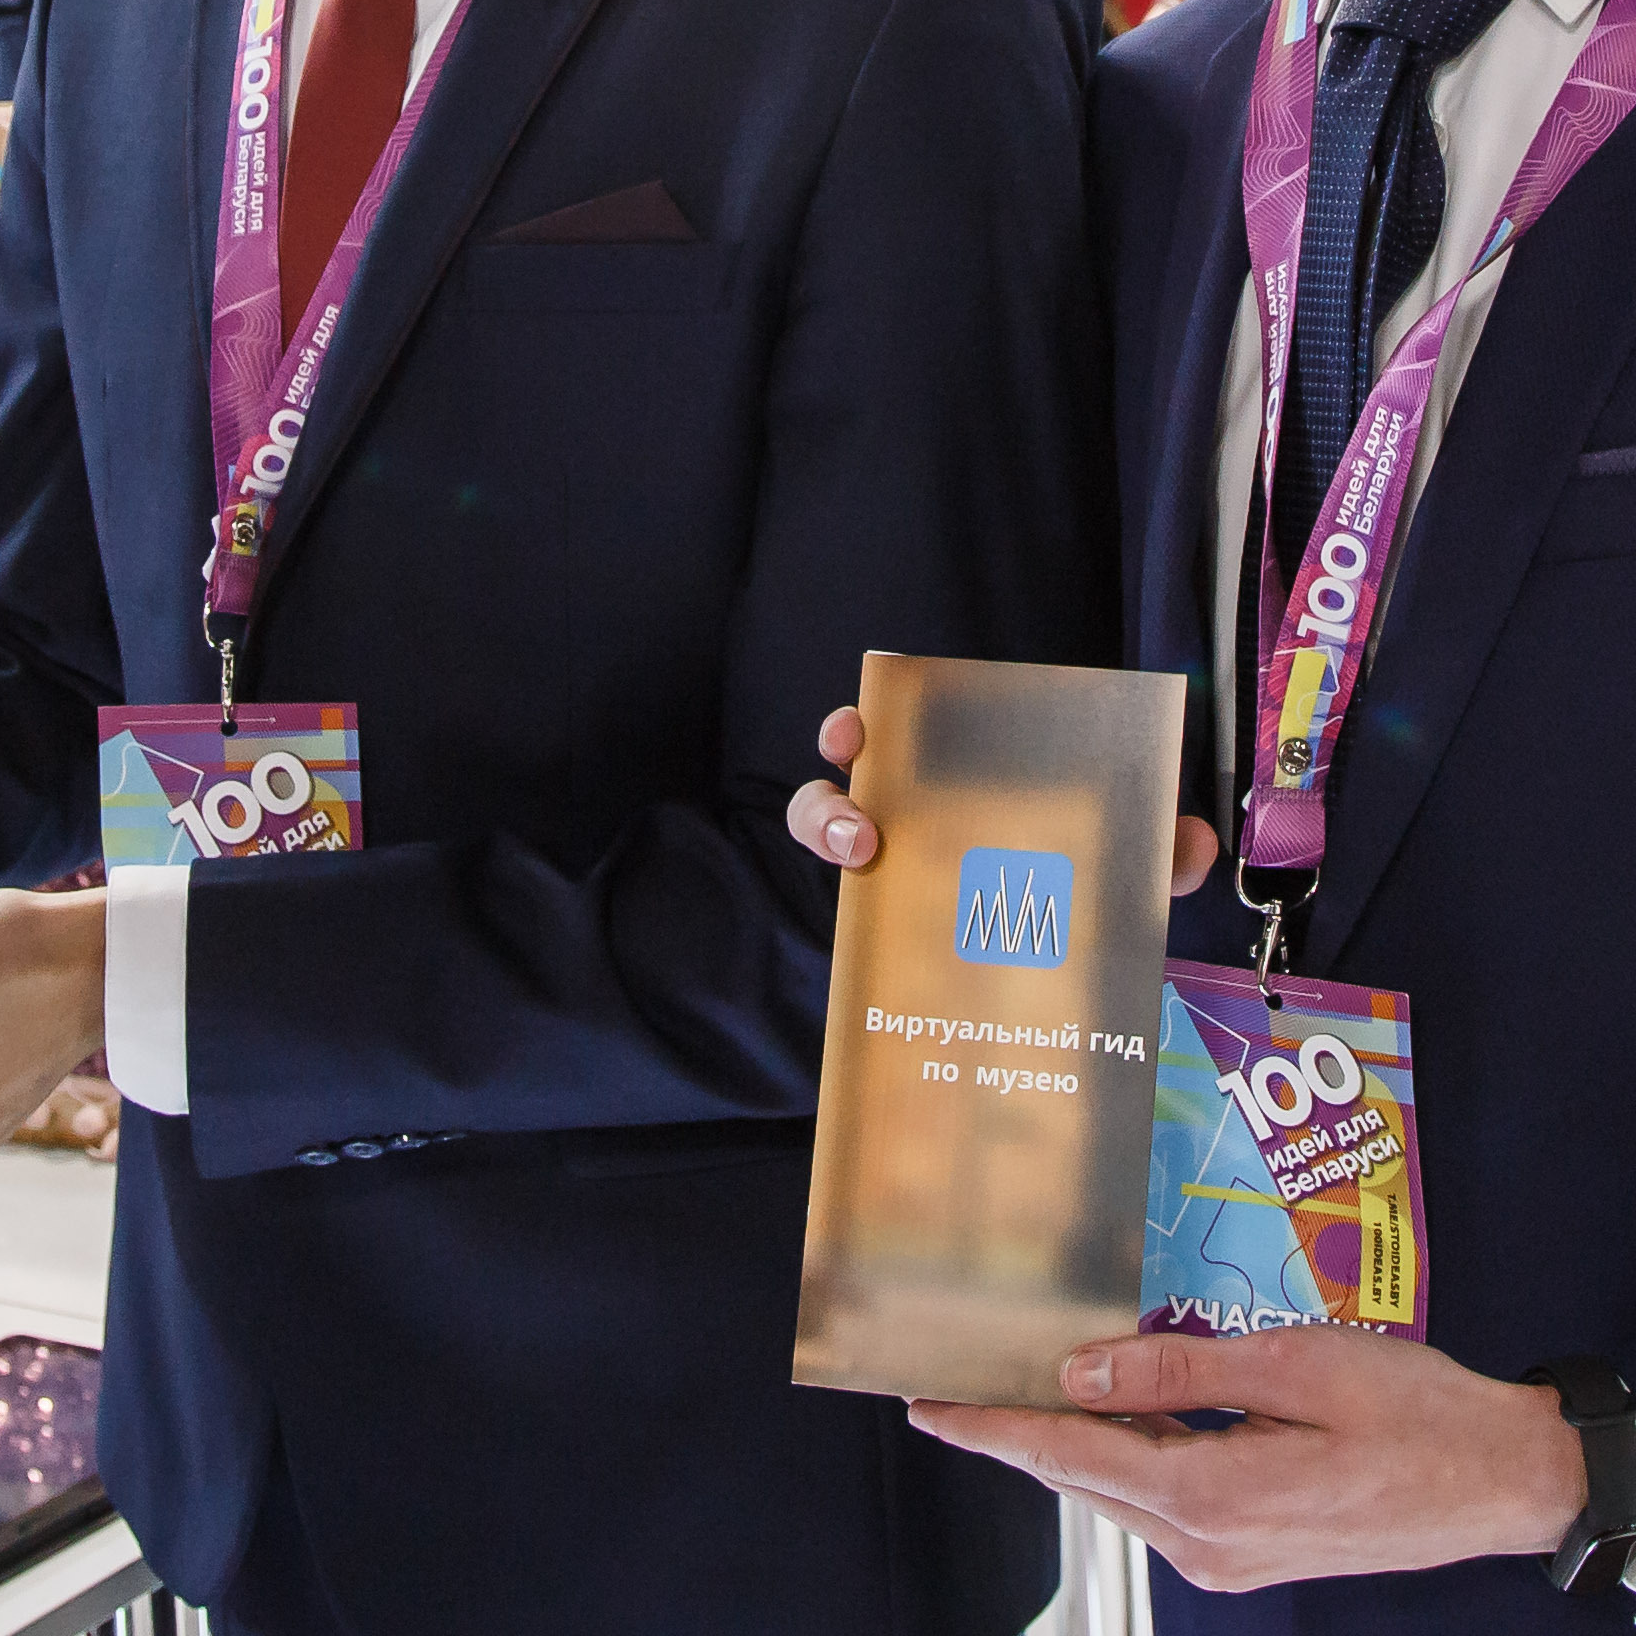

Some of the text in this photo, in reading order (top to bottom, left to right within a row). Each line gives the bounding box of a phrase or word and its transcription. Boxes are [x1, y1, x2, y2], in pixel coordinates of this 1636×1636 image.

[237, 36, 273, 131] 100
[232, 134, 252, 236] Беларуси
[249, 130, 268, 231] идей для
[1264, 268, 1279, 318] для
[283, 347, 319, 405] идей
[311, 304, 341, 350] для
[239, 408, 306, 496] 100
[1335, 405, 1390, 527] идей для
[1352, 412, 1404, 535] Беларуси
[1296, 532, 1368, 642] 100
[167, 751, 313, 858] 100
[865, 1006, 1147, 1062] Виртуальный гид
[922, 1060, 1080, 1095] по музею
[1215, 1033, 1363, 1142] 100
[1265, 1107, 1386, 1174] идей для
[1276, 1133, 1402, 1202] Беларуси
[1167, 1294, 1388, 1335] УЧАСТ
